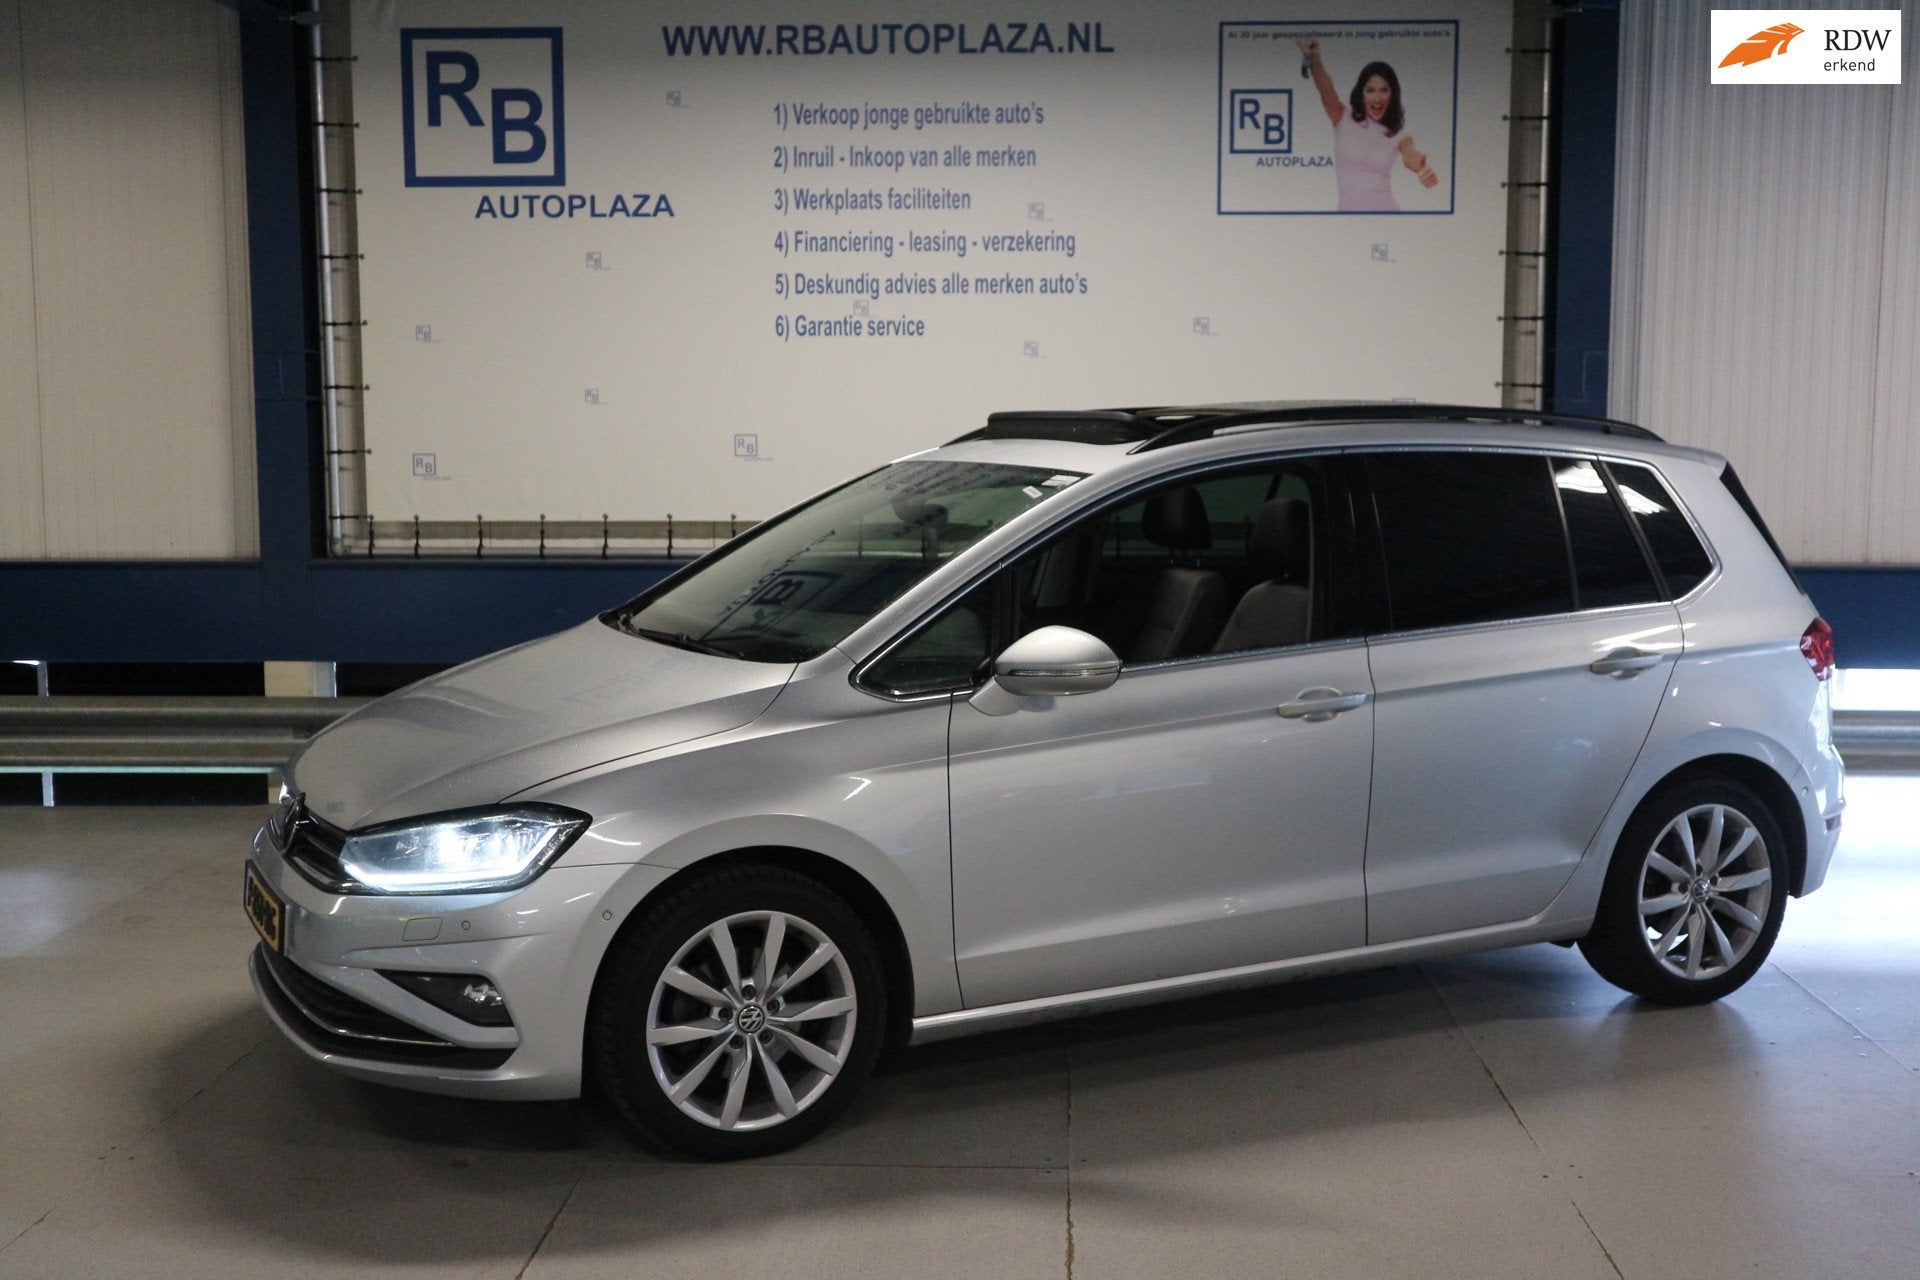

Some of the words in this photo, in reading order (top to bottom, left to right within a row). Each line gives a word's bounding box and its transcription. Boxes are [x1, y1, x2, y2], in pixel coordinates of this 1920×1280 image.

[661, 22, 1115, 56] WWW.RBAUTOPLAZA.NL
[774, 103, 788, 130] 1)
[793, 103, 860, 130] Verkoop
[863, 104, 910, 130] jonge
[914, 103, 990, 130] gebruikte
[774, 146, 789, 173] 2)
[793, 145, 834, 168] Inruil
[849, 145, 905, 172] Inkoop
[910, 150, 938, 167] van
[943, 145, 972, 167] alle
[976, 145, 1037, 167] merken
[1256, 156, 1334, 168] AUTOPLAZA
[474, 193, 675, 219] AUTOPLAZA
[774, 188, 789, 215] 3)
[793, 187, 883, 215] Werkplaats
[887, 187, 971, 210] faciliteiten
[774, 230, 789, 257] 4)
[794, 230, 894, 258] Financiering
[909, 230, 967, 258] leasing
[982, 230, 1076, 257] verzekering
[775, 273, 790, 300] 5)
[794, 272, 880, 300] Deskundig
[884, 272, 937, 295] advies
[941, 272, 970, 295] alle
[974, 272, 1035, 295] merken
[775, 315, 790, 342] 6)
[795, 314, 863, 337] Garantie
[867, 318, 926, 337] service
